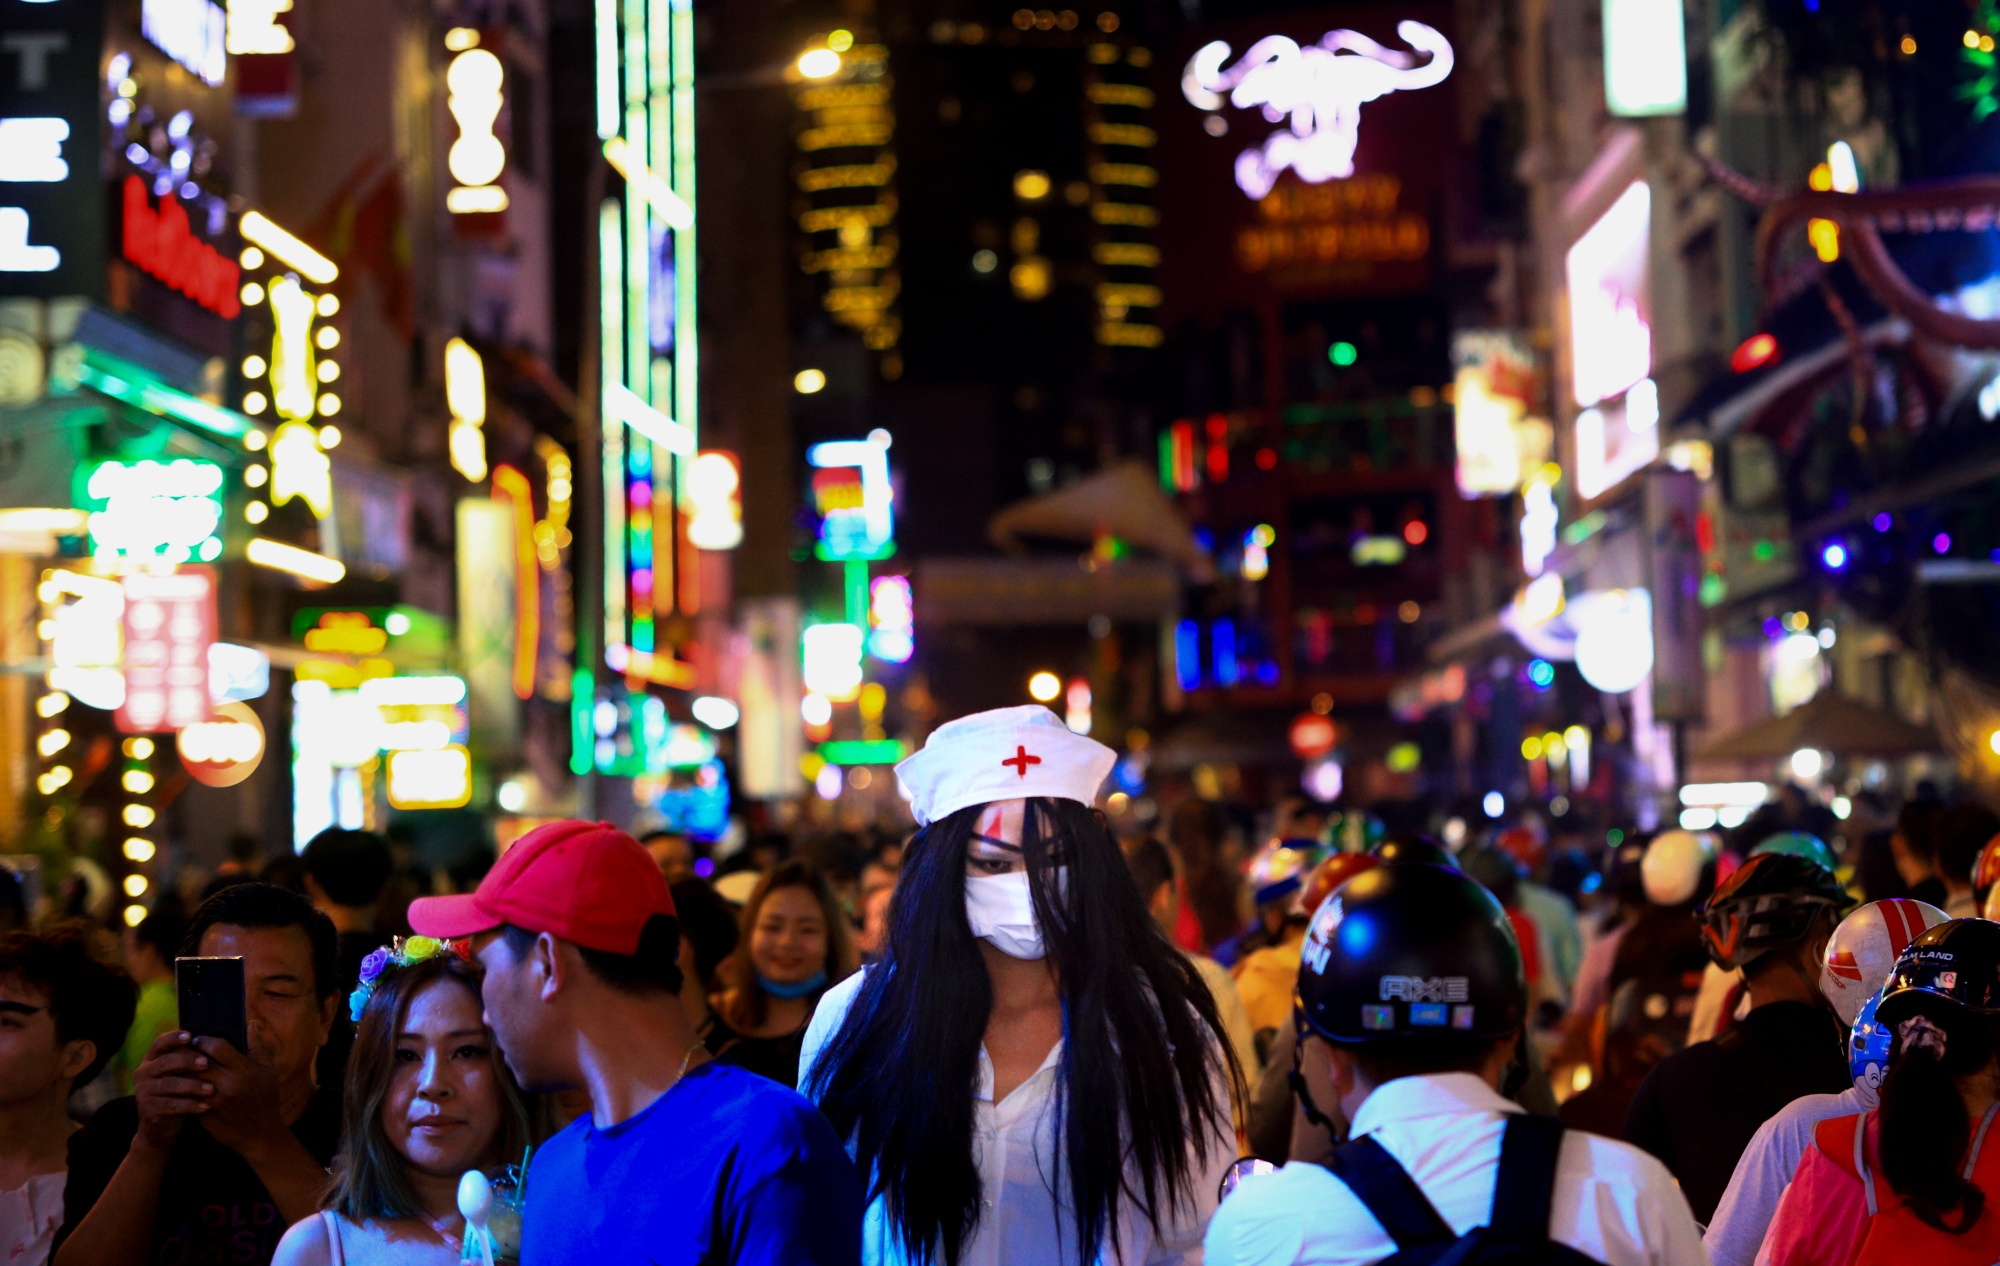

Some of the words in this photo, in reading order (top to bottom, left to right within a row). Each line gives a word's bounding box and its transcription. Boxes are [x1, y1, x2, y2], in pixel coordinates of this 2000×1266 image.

[0, 0, 71, 273] TEL
[1919, 951, 1954, 961] LAND
[1379, 975, 1469, 1002] AXE
